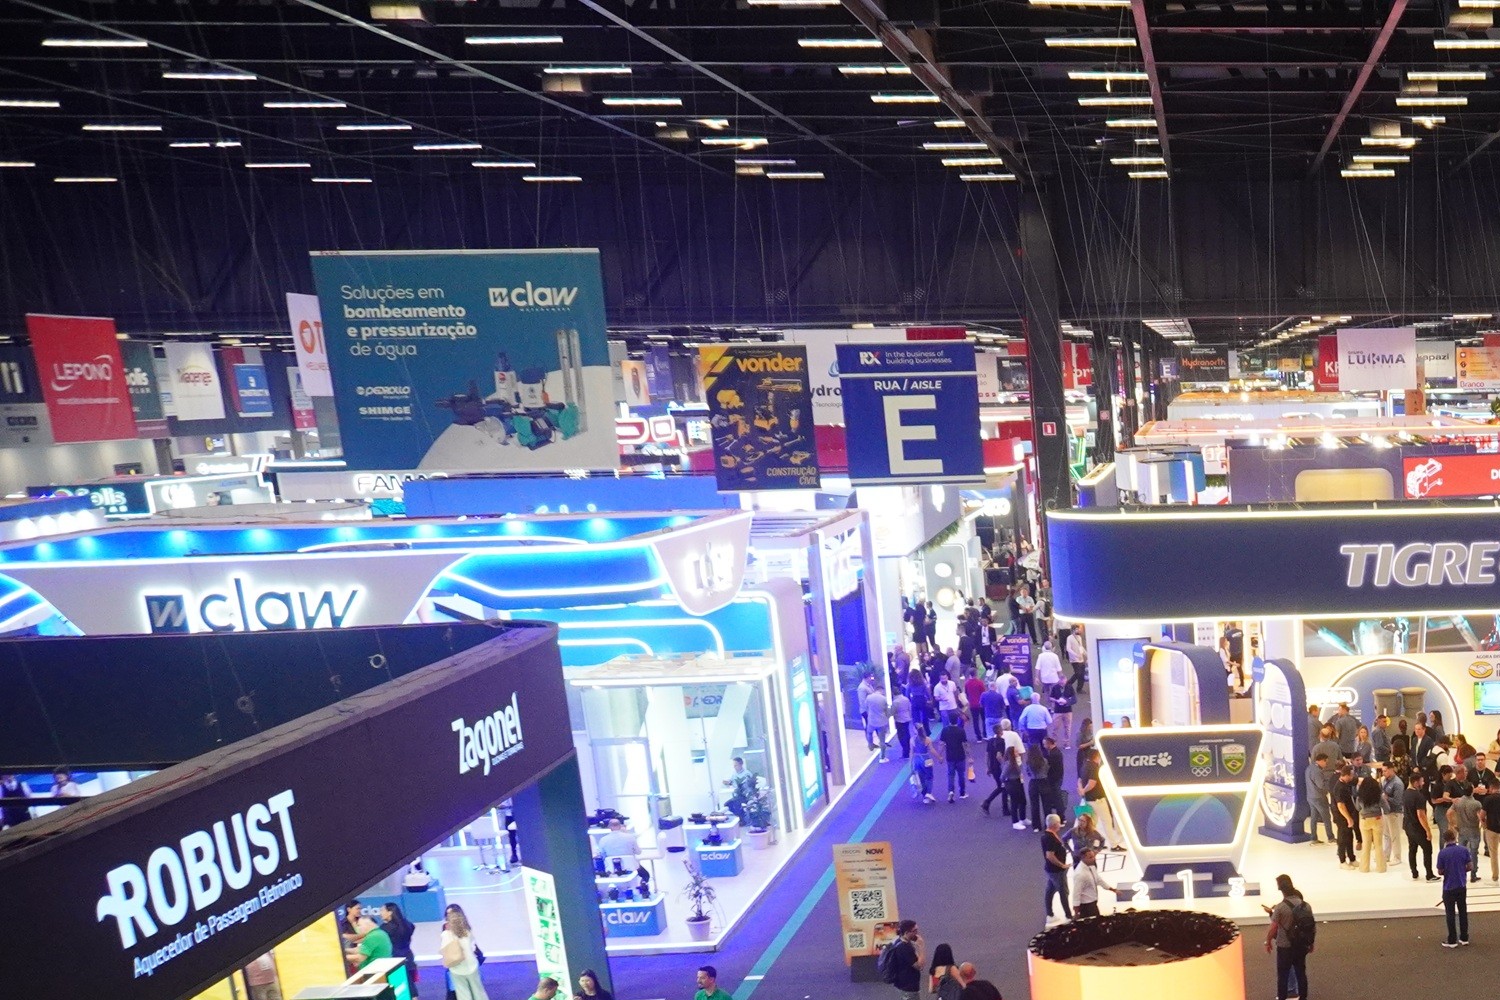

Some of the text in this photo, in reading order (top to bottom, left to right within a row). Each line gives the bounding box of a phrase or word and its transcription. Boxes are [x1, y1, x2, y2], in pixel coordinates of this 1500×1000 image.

[341, 284, 444, 304] Soluções em
[511, 281, 578, 306] claw
[344, 304, 466, 318] bombeamento
[347, 322, 477, 340] e pressurização
[350, 342, 417, 361] de água
[859, 351, 882, 365] RX
[885, 357, 914, 365] building
[53, 362, 113, 381] LEPONO
[736, 352, 803, 372] vonder
[1181, 357, 1227, 371] Hydronorth
[874, 379, 943, 391] RUA / AISLE
[359, 406, 411, 415] SHIMGE
[882, 394, 943, 475] E
[766, 465, 817, 478] CONSTRUÇÃO
[799, 475, 818, 486] CIVIL
[1341, 541, 1500, 588] TIGRE
[199, 578, 362, 632] claw
[451, 691, 523, 776] Zagonel
[1116, 754, 1157, 767] TIGRE
[708, 852, 731, 861] claw
[97, 788, 299, 950] ROBUST
[1132, 877, 1245, 901] 2 3
[1177, 869, 1194, 907] 1
[133, 873, 303, 979] Aquecedor de Passagem Eletrônico
[606, 909, 651, 924] claw
